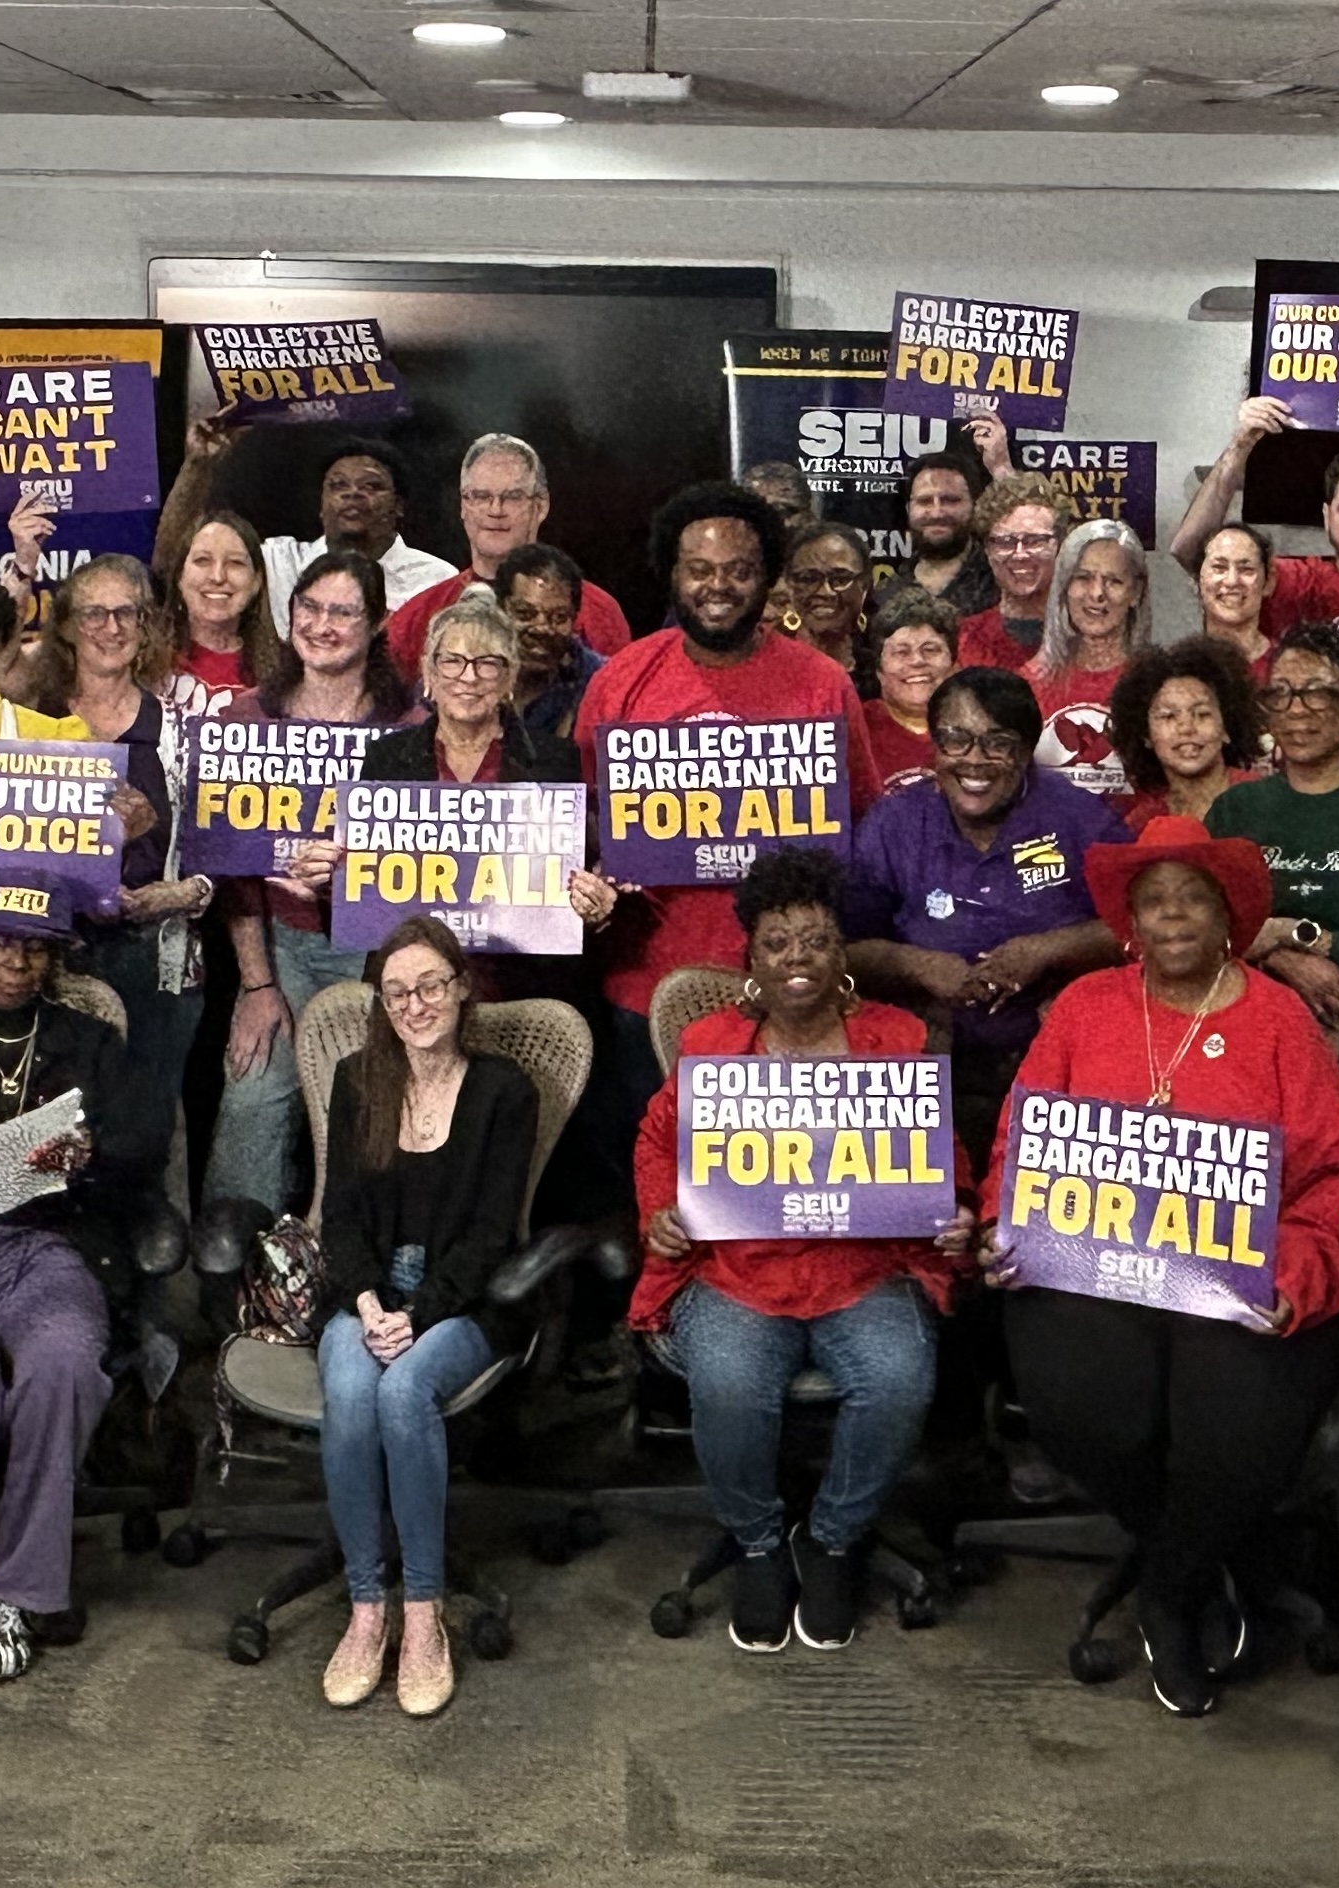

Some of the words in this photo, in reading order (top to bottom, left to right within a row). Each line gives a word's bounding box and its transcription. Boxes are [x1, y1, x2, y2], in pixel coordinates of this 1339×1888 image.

[902, 297, 1070, 338] COLLECTIVE
[1275, 304, 1313, 322] OUR
[204, 324, 376, 349] COLLECTIVE
[899, 321, 1067, 361] BARGAINING
[1271, 323, 1333, 351] OUR
[210, 344, 382, 369] BARGAINING
[895, 344, 979, 389] FOR
[986, 355, 1063, 398] ALL
[1268, 352, 1337, 384] OUR
[217, 369, 308, 401] FOR
[312, 363, 395, 396] ALL
[798, 410, 948, 459] SEIU
[798, 456, 905, 475] VIRGINIA
[1021, 444, 1129, 469] CARE
[1049, 470, 1129, 495] AN'T
[199, 721, 396, 758] COLLECTI
[607, 721, 836, 760] COLLECTIVE
[198, 754, 364, 785] BARGAINI
[608, 755, 838, 791] BARGAINING
[196, 782, 302, 833] FOR
[347, 786, 577, 823] COLLECTIVE
[610, 790, 724, 840] FOR
[734, 786, 842, 838] ALL
[346, 821, 575, 854] BARGAINING
[345, 852, 459, 904] FOR
[469, 854, 572, 907] ALL
[1018, 863, 1066, 889] SEIU
[692, 1061, 940, 1097] COLLECTIVE
[692, 1097, 941, 1130] BARGAINING
[1021, 1095, 1270, 1171] COLLECTIVE
[692, 1130, 815, 1186] FOR
[827, 1129, 945, 1184] ALL
[1017, 1133, 1268, 1207] BARGAINING
[782, 1192, 850, 1216] SEIU
[1011, 1168, 1137, 1245] FOR
[1145, 1192, 1266, 1268] ALL
